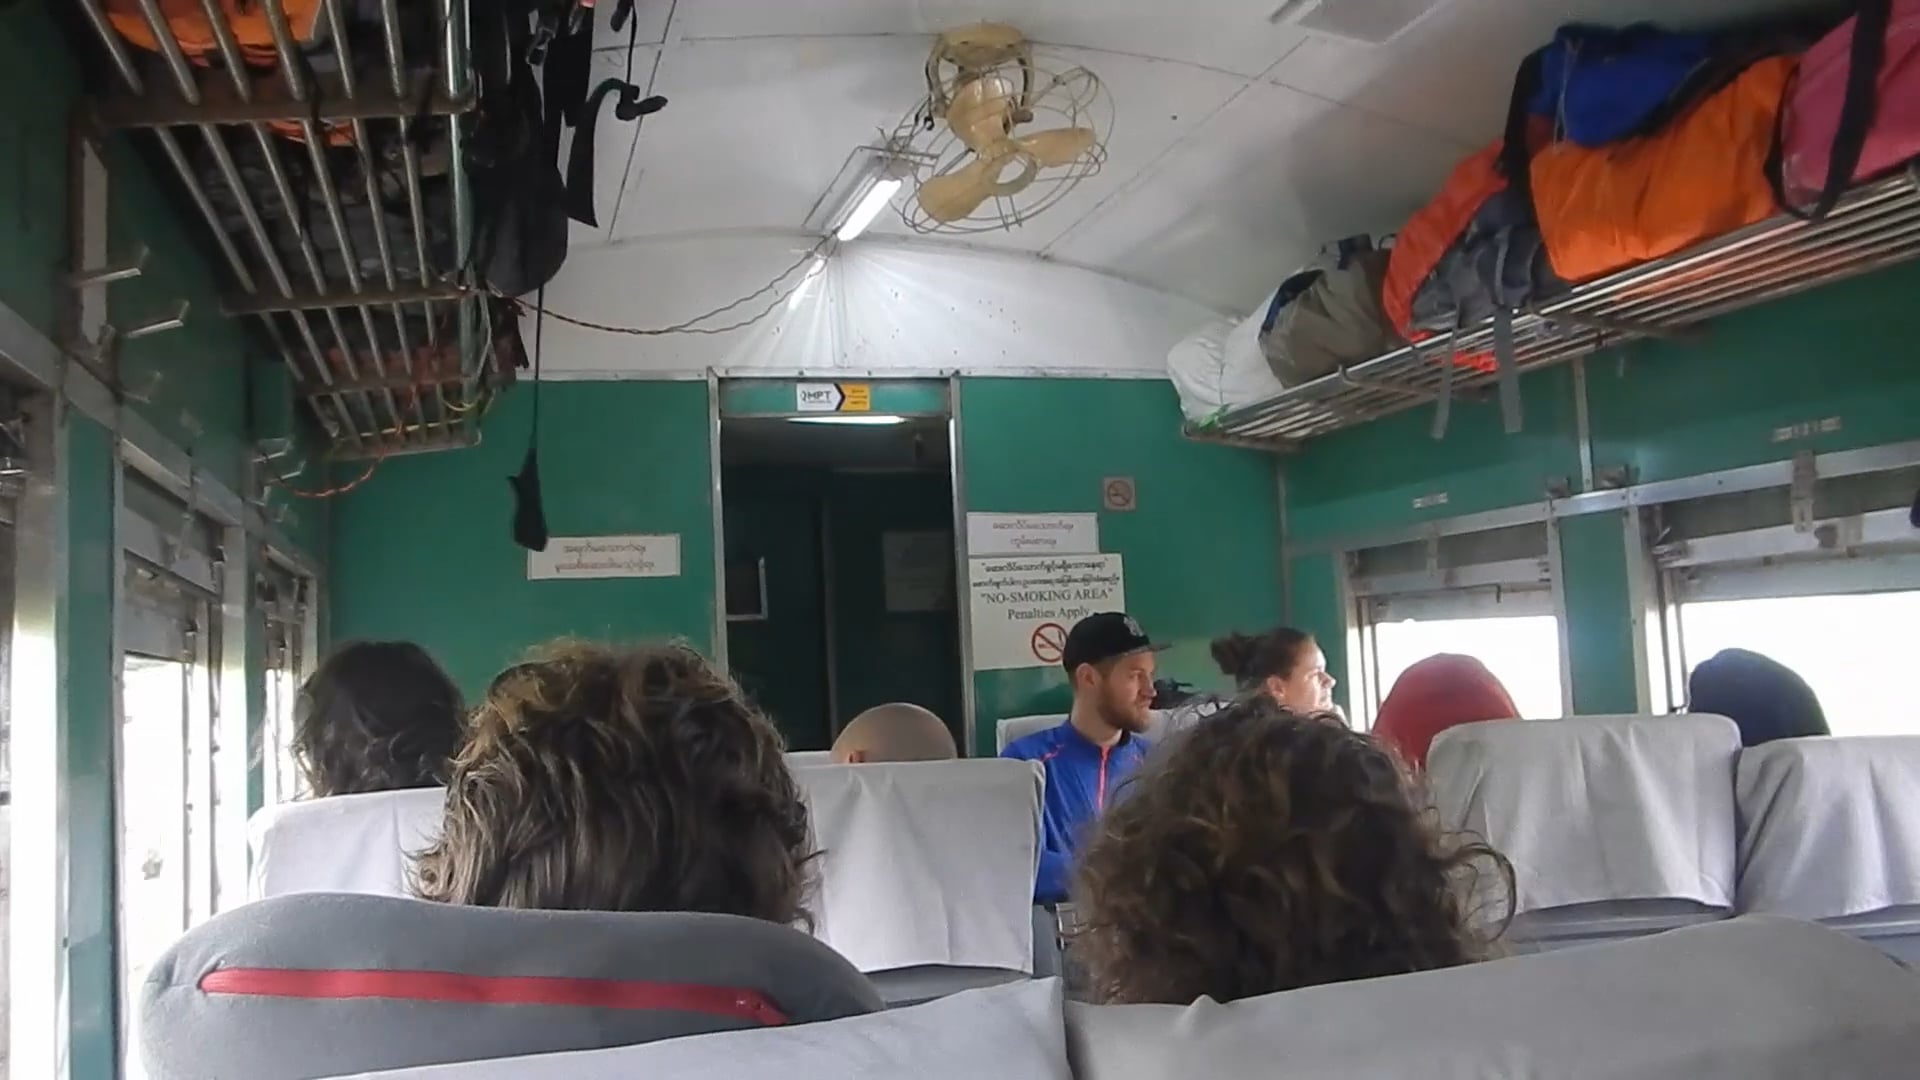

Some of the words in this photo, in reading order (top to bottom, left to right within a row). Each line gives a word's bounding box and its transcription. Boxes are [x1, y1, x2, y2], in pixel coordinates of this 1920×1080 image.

[807, 390, 831, 400] MPT
[980, 589, 1071, 604] "NO-SMOKING
[1074, 588, 1113, 600] AREA"
[1007, 607, 1056, 620] Penalties
[1057, 606, 1090, 621] Apply
